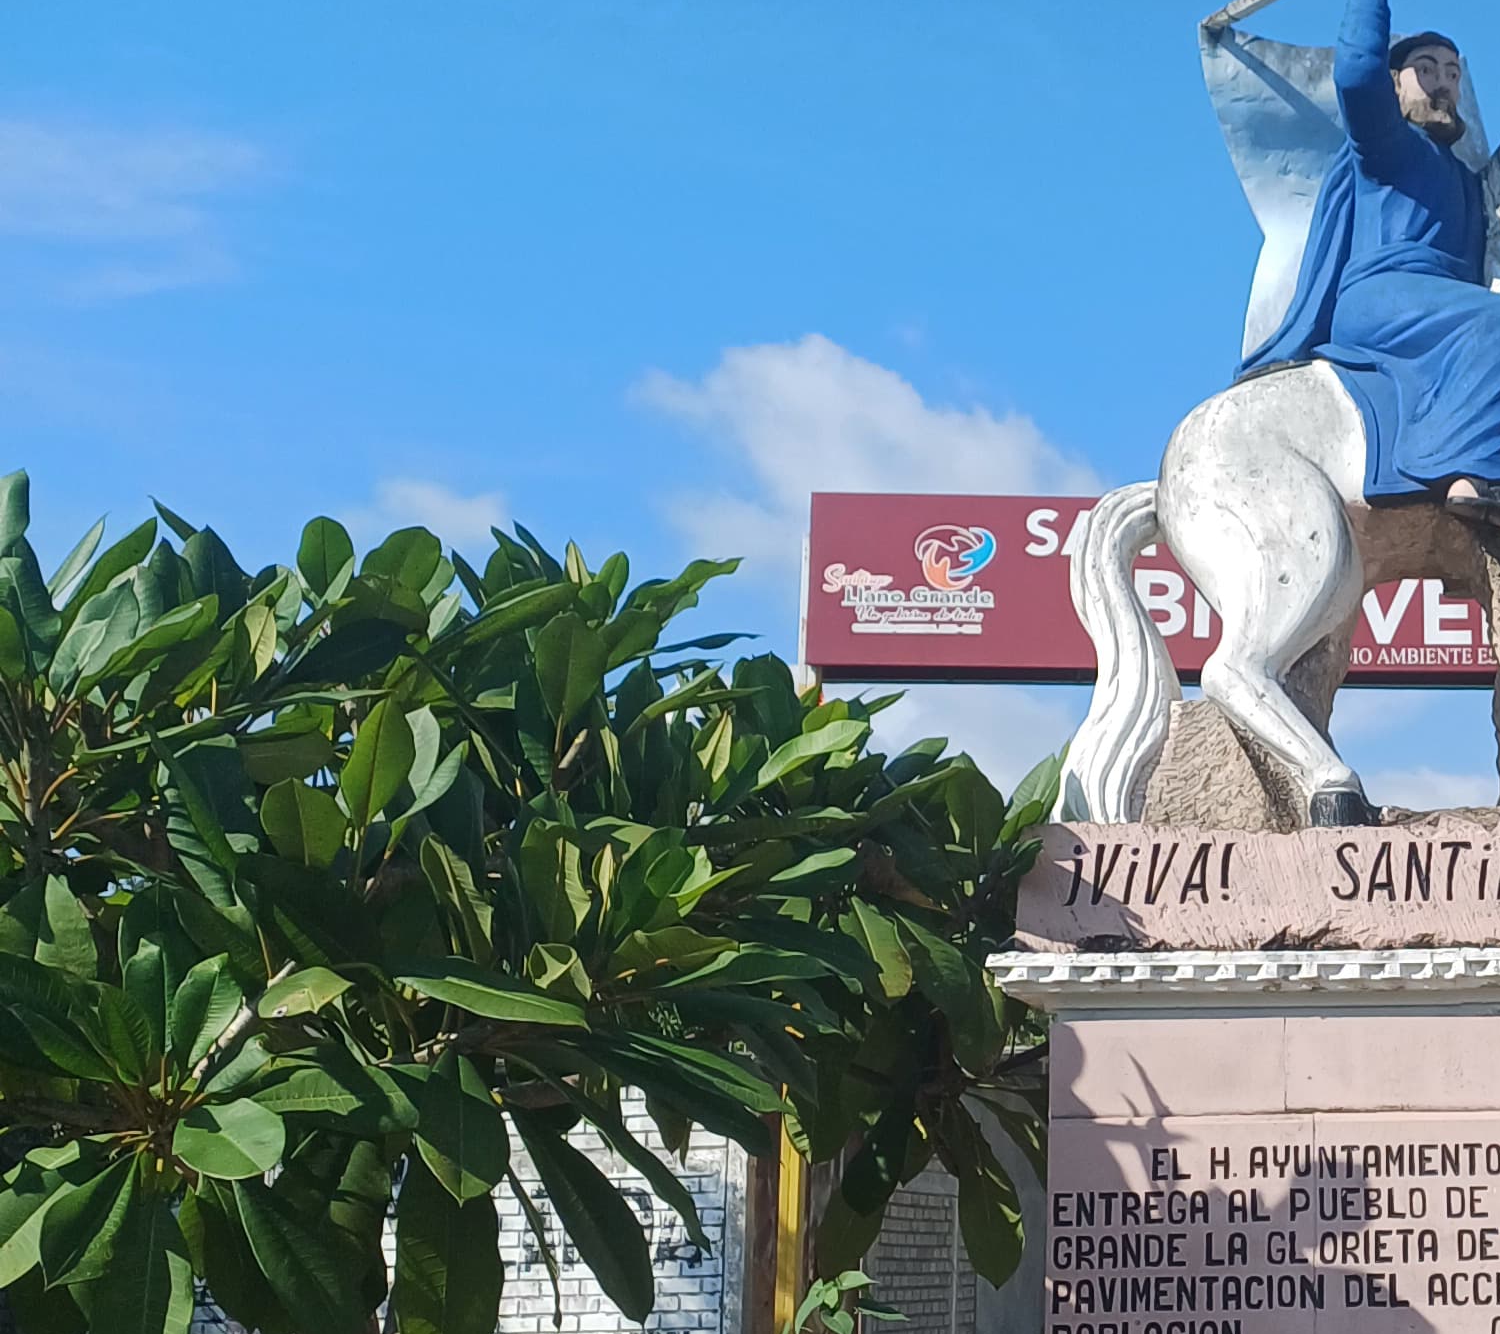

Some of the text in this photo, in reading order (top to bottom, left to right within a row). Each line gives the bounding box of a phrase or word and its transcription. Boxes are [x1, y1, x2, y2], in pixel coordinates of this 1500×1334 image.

[845, 585, 993, 605] Llano Grande
[1376, 647, 1473, 665] AMBIENTE
[1151, 1147, 1192, 1182] EL
[1209, 1146, 1238, 1180] H.
[1052, 1189, 1209, 1228] ENTREGA
[1228, 1188, 1271, 1224] AL
[1289, 1185, 1428, 1222] PUEBLO
[1445, 1185, 1490, 1220] DE
[1052, 1232, 1188, 1271] GRANDE
[1205, 1231, 1248, 1267] LA
[1266, 1227, 1439, 1266] GLORIETA
[1457, 1228, 1500, 1262] DE
[1051, 1273, 1325, 1315] PAVIMENTACION
[1344, 1272, 1410, 1309] DEL
